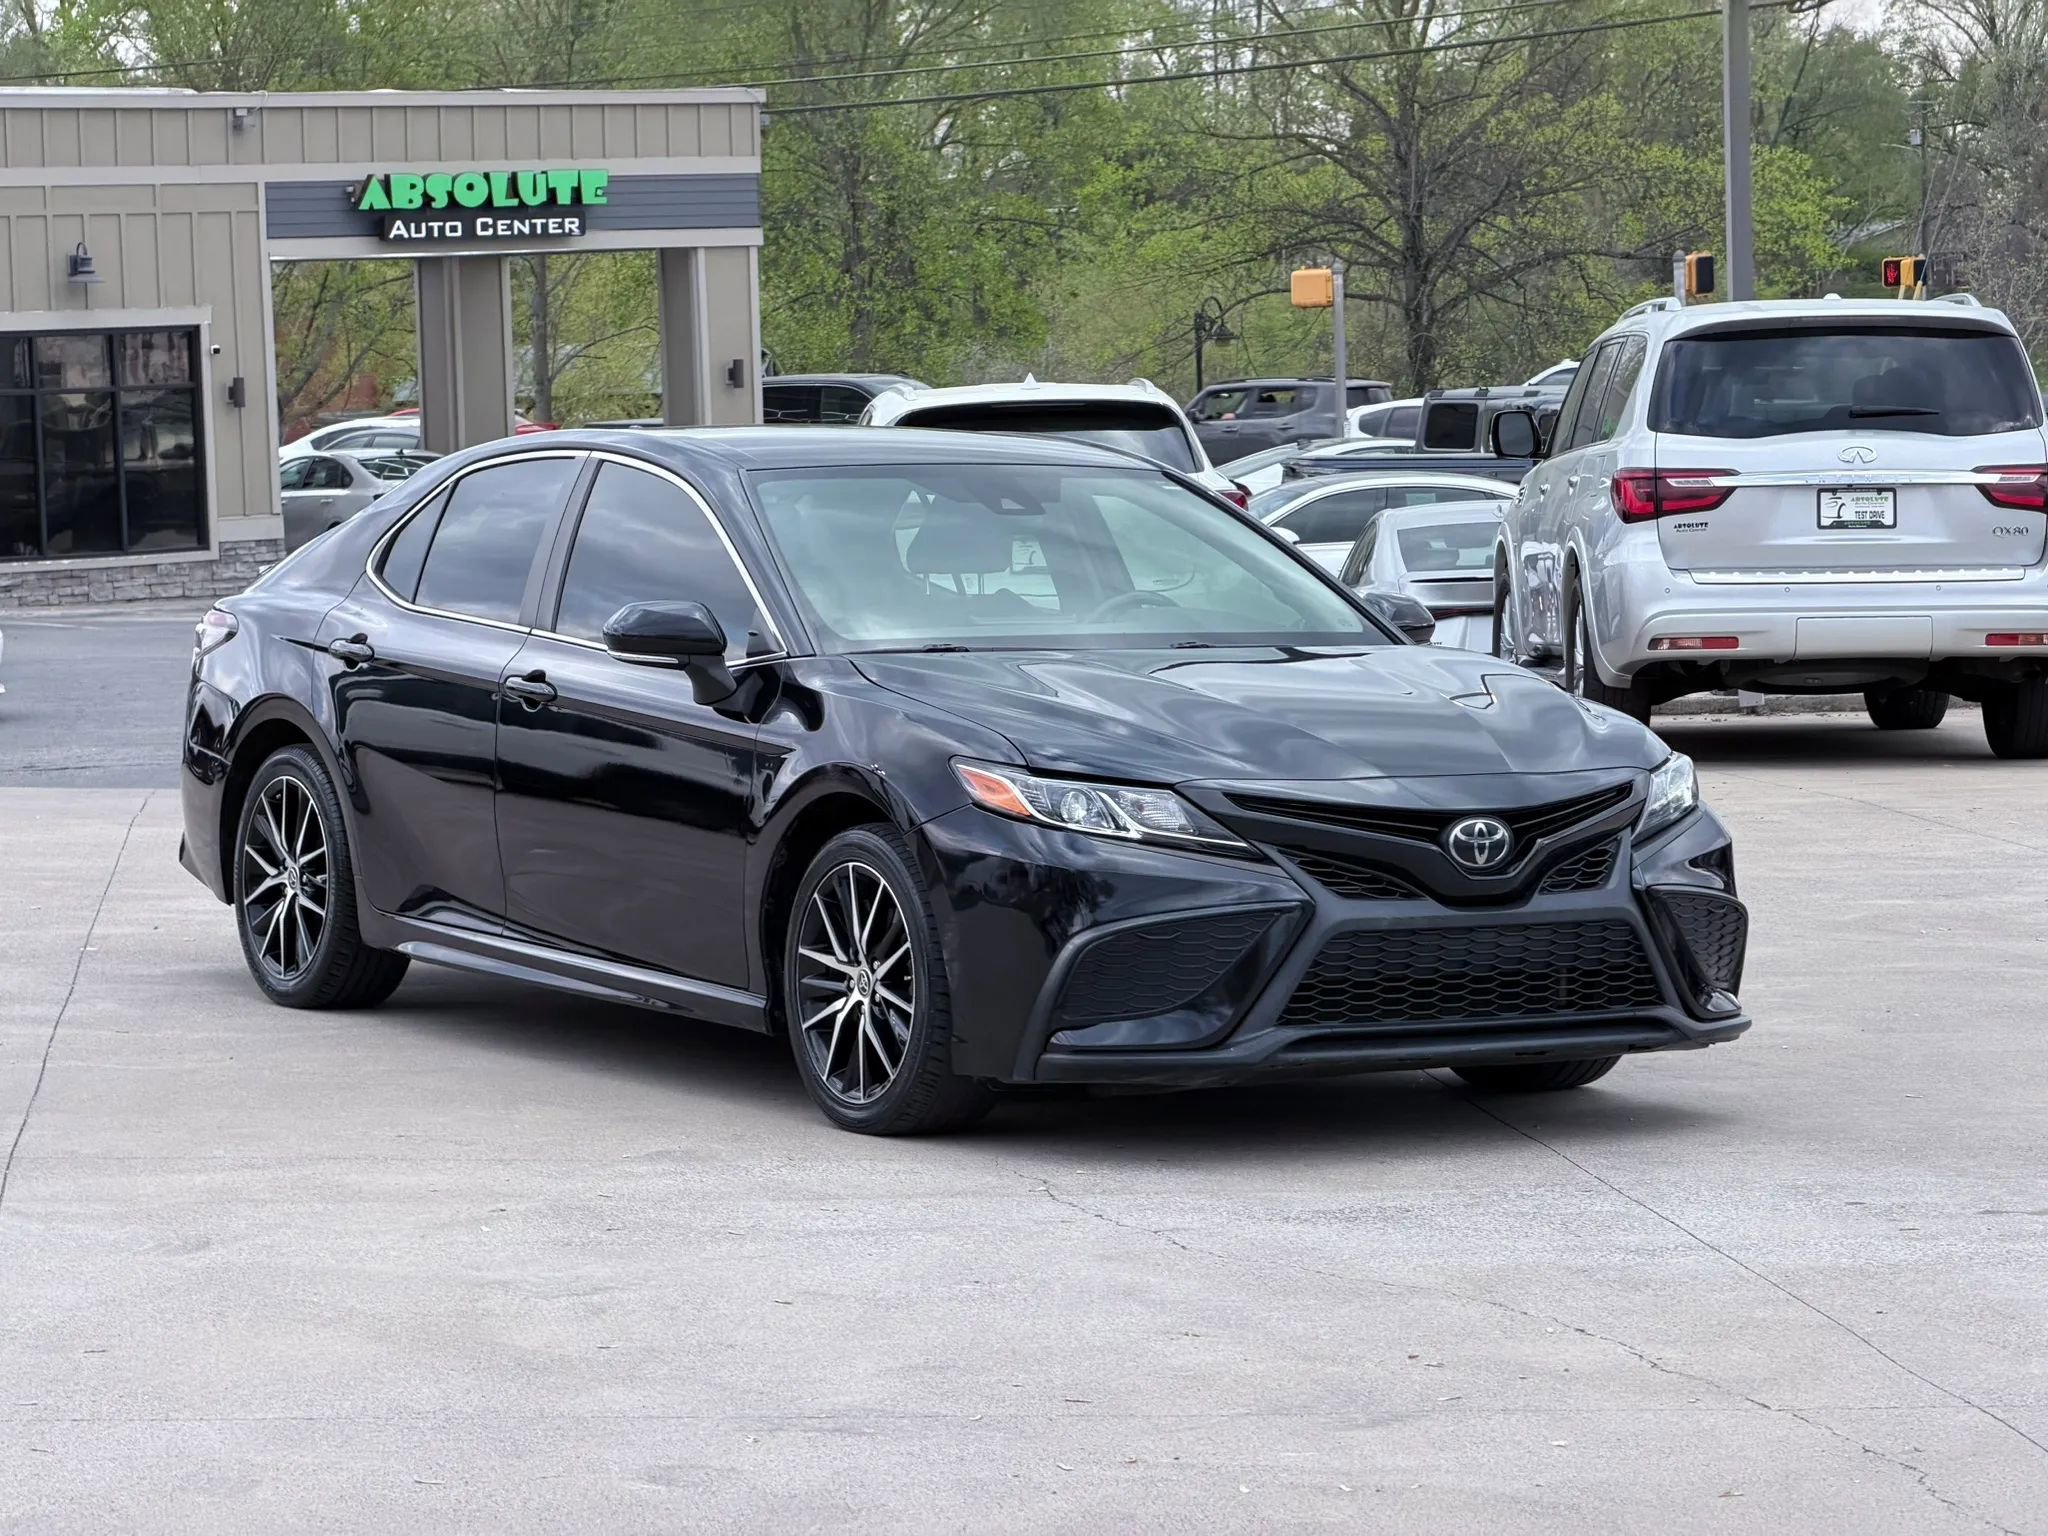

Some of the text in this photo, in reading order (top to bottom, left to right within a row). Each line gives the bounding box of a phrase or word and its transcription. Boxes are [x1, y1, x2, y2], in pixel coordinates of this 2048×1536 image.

[357, 169, 609, 211] ABSOLUTE
[388, 216, 580, 240] AUTO CENTER
[1855, 510, 1885, 519] TEST DRIVE
[1992, 526, 2029, 538] QX80
